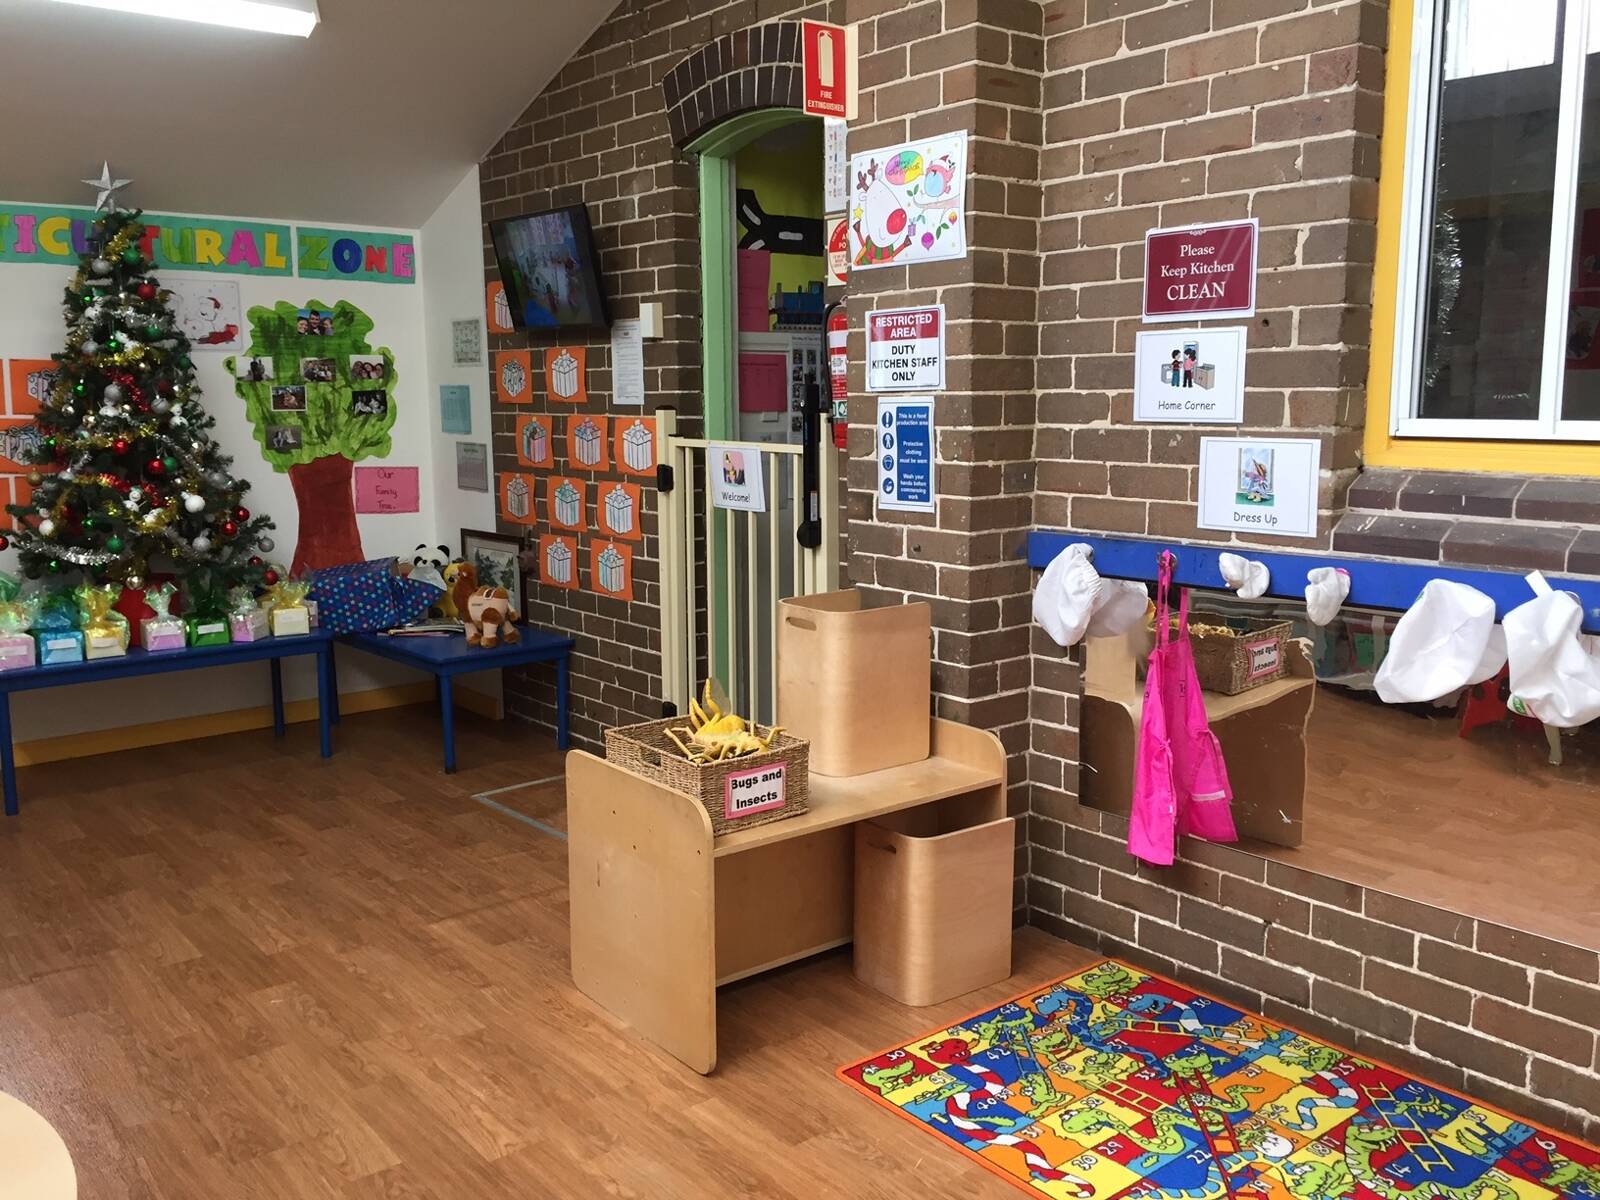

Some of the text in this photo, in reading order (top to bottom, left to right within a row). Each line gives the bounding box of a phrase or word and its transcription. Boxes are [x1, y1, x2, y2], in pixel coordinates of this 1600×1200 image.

[820, 91, 833, 99] FIRE
[808, 100, 844, 112] EXTINGUISHER
[301, 236, 414, 278] ZONE
[1180, 244, 1215, 257] Please
[1161, 262, 1234, 279] Keep Kitchen
[1167, 282, 1226, 301] CLEAN
[876, 314, 932, 328] RESTRICTED
[890, 328, 916, 338] AREA
[892, 345, 916, 354] DUTY
[872, 357, 938, 369] KITCHEN STAFF
[892, 372, 916, 381] ONLY
[1158, 400, 1216, 411] Home Corner
[377, 468, 394, 479] Our
[722, 492, 750, 502] Welcome!
[1233, 512, 1278, 526] Dress Up
[732, 768, 782, 790] Bugs and
[736, 792, 778, 810] Insects
[1000, 1004, 1020, 1014] 48
[886, 1050, 906, 1061] 50
[986, 1048, 1010, 1060] 42
[1332, 1062, 1356, 1076] 25
[976, 1097, 996, 1110] 40
[1098, 1141, 1123, 1155] 29
[1072, 1154, 1098, 1170] 30
[1187, 1150, 1212, 1164] 22
[1385, 1163, 1412, 1178] 14
